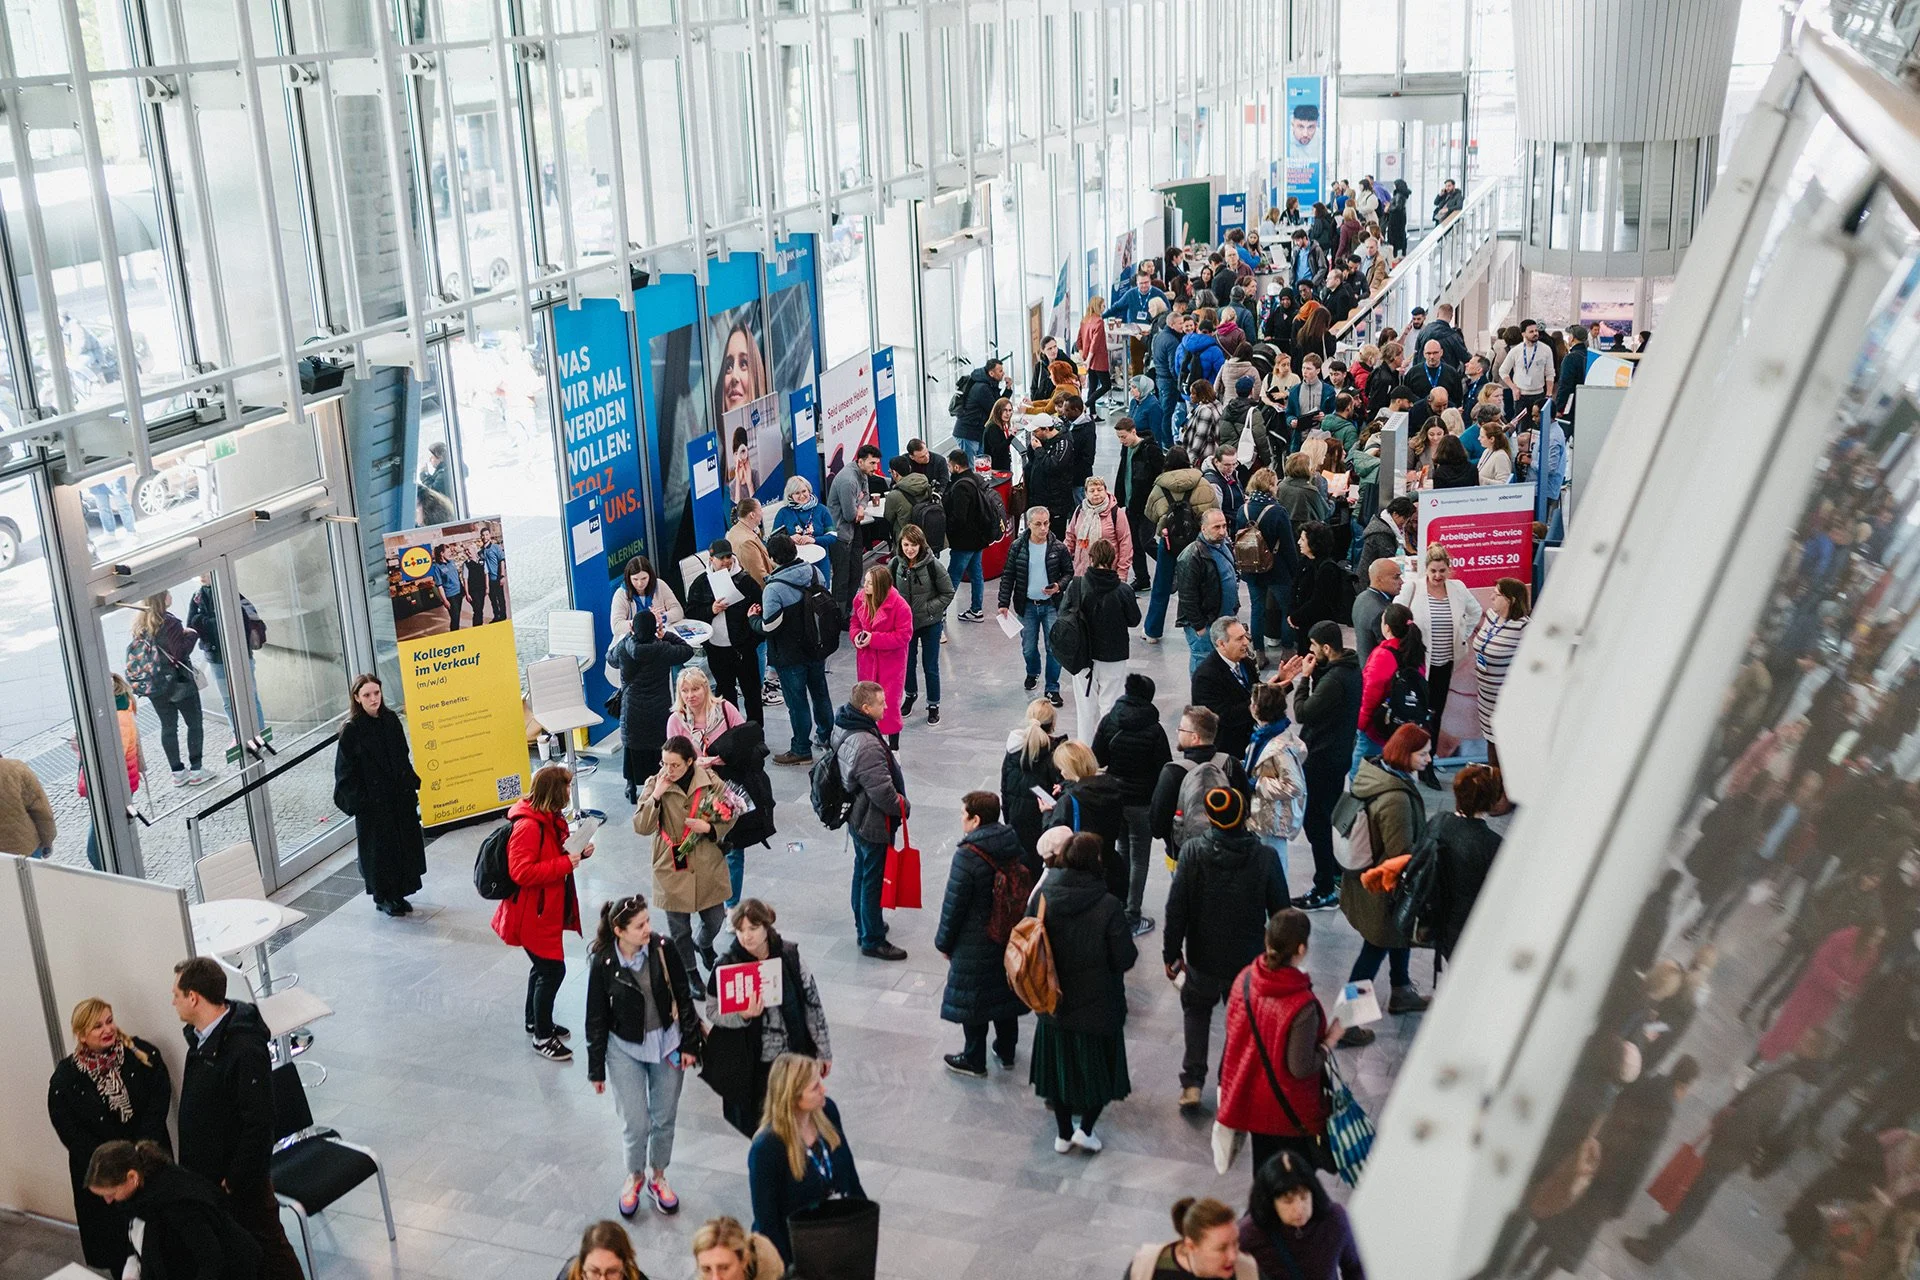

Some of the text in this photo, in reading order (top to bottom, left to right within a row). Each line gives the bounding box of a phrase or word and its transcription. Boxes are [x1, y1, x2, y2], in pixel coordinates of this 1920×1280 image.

[796, 247, 808, 259] Berlin
[592, 366, 627, 400] MAL
[827, 404, 838, 419] Seid
[838, 397, 853, 412] unsere
[853, 387, 868, 402] Helden
[831, 424, 837, 435] in
[845, 405, 868, 426] Reinigung
[570, 467, 615, 499] TOLZ
[604, 488, 641, 523] UNS.
[590, 519, 599, 531] P25
[1440, 531, 1486, 541] Arbeitgeber
[1493, 529, 1523, 537] Service
[1468, 556, 1475, 566] 4
[1478, 554, 1504, 566] 5555
[1506, 553, 1520, 564] 20
[413, 644, 465, 662] Kollegen
[415, 653, 480, 676] im Verkauf
[416, 676, 447, 690] (m/w/d)
[420, 695, 470, 712] Deine Benefits:
[434, 804, 476, 820] jobs.lidl.de
